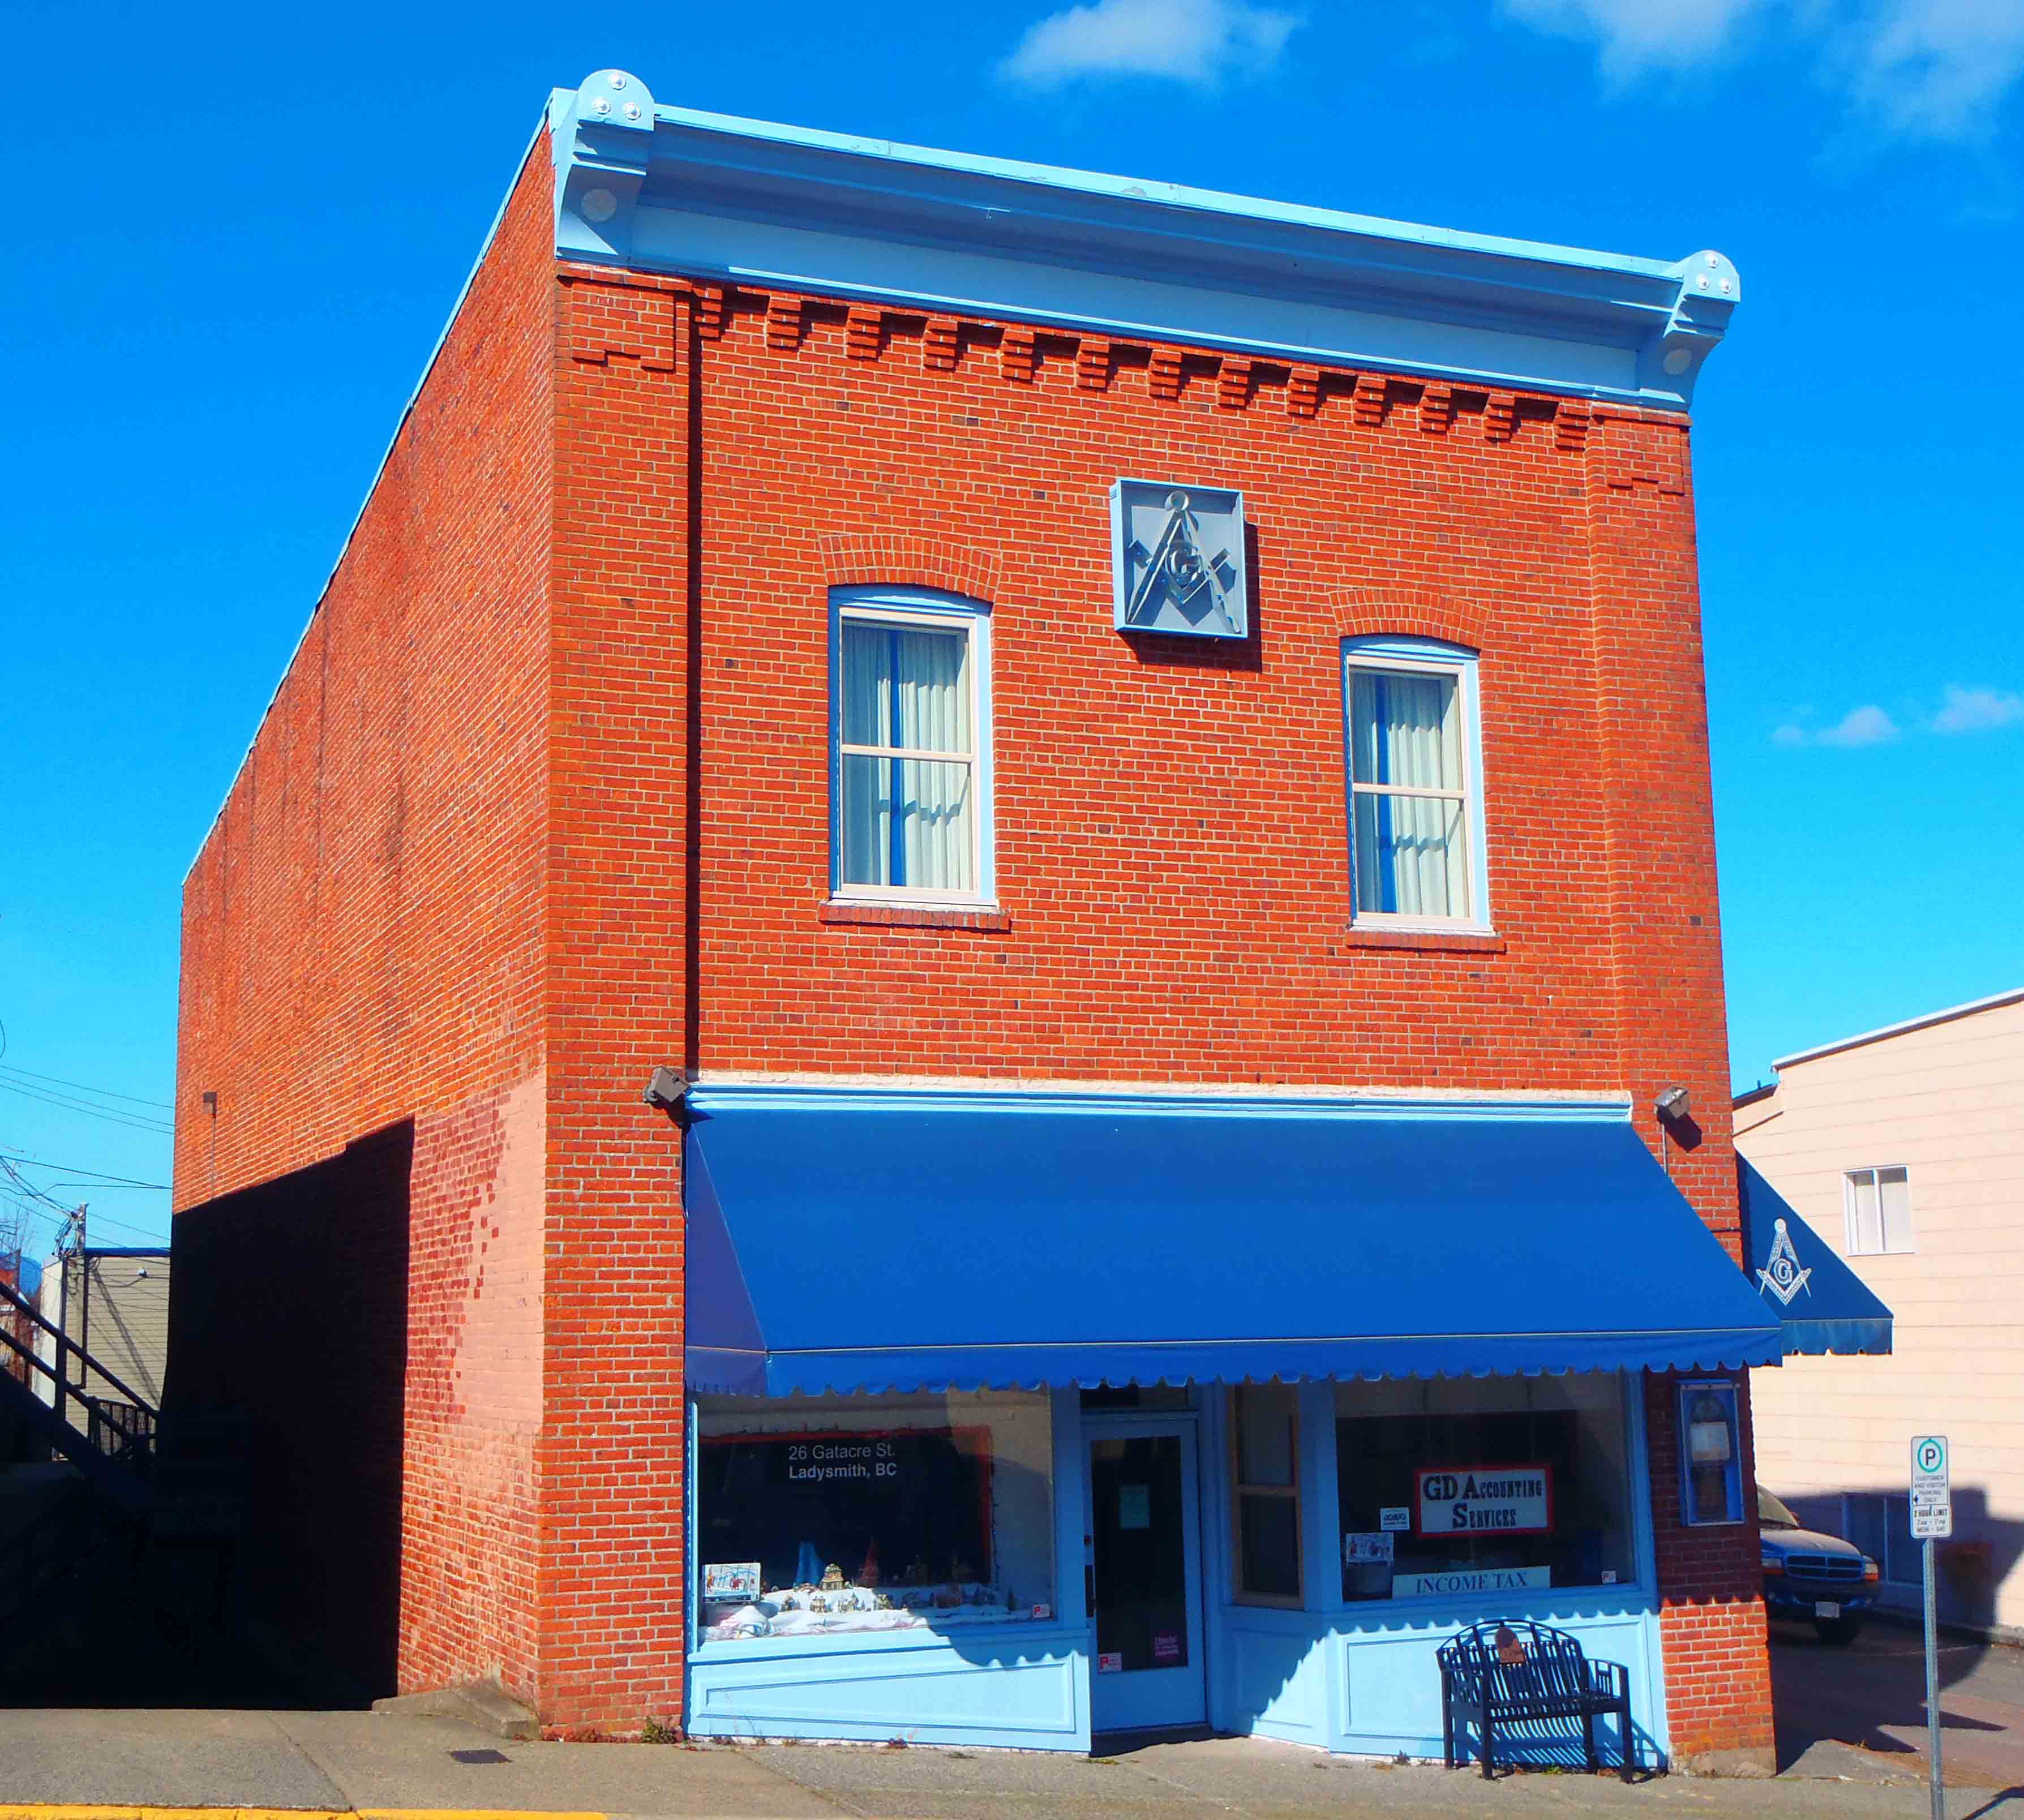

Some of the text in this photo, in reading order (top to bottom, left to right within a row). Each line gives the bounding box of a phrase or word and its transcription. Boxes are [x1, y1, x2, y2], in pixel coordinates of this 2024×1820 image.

[1774, 1258, 1793, 1285] G
[788, 1443, 895, 1461] 26 Gatacre St.
[1925, 1448, 1936, 1466] P
[788, 1462, 897, 1482] Ladysmith, BC
[1423, 1474, 1459, 1500] GD
[1452, 1503, 1517, 1528] SERVICES
[1417, 1572, 1527, 1594] INCOME TAX
